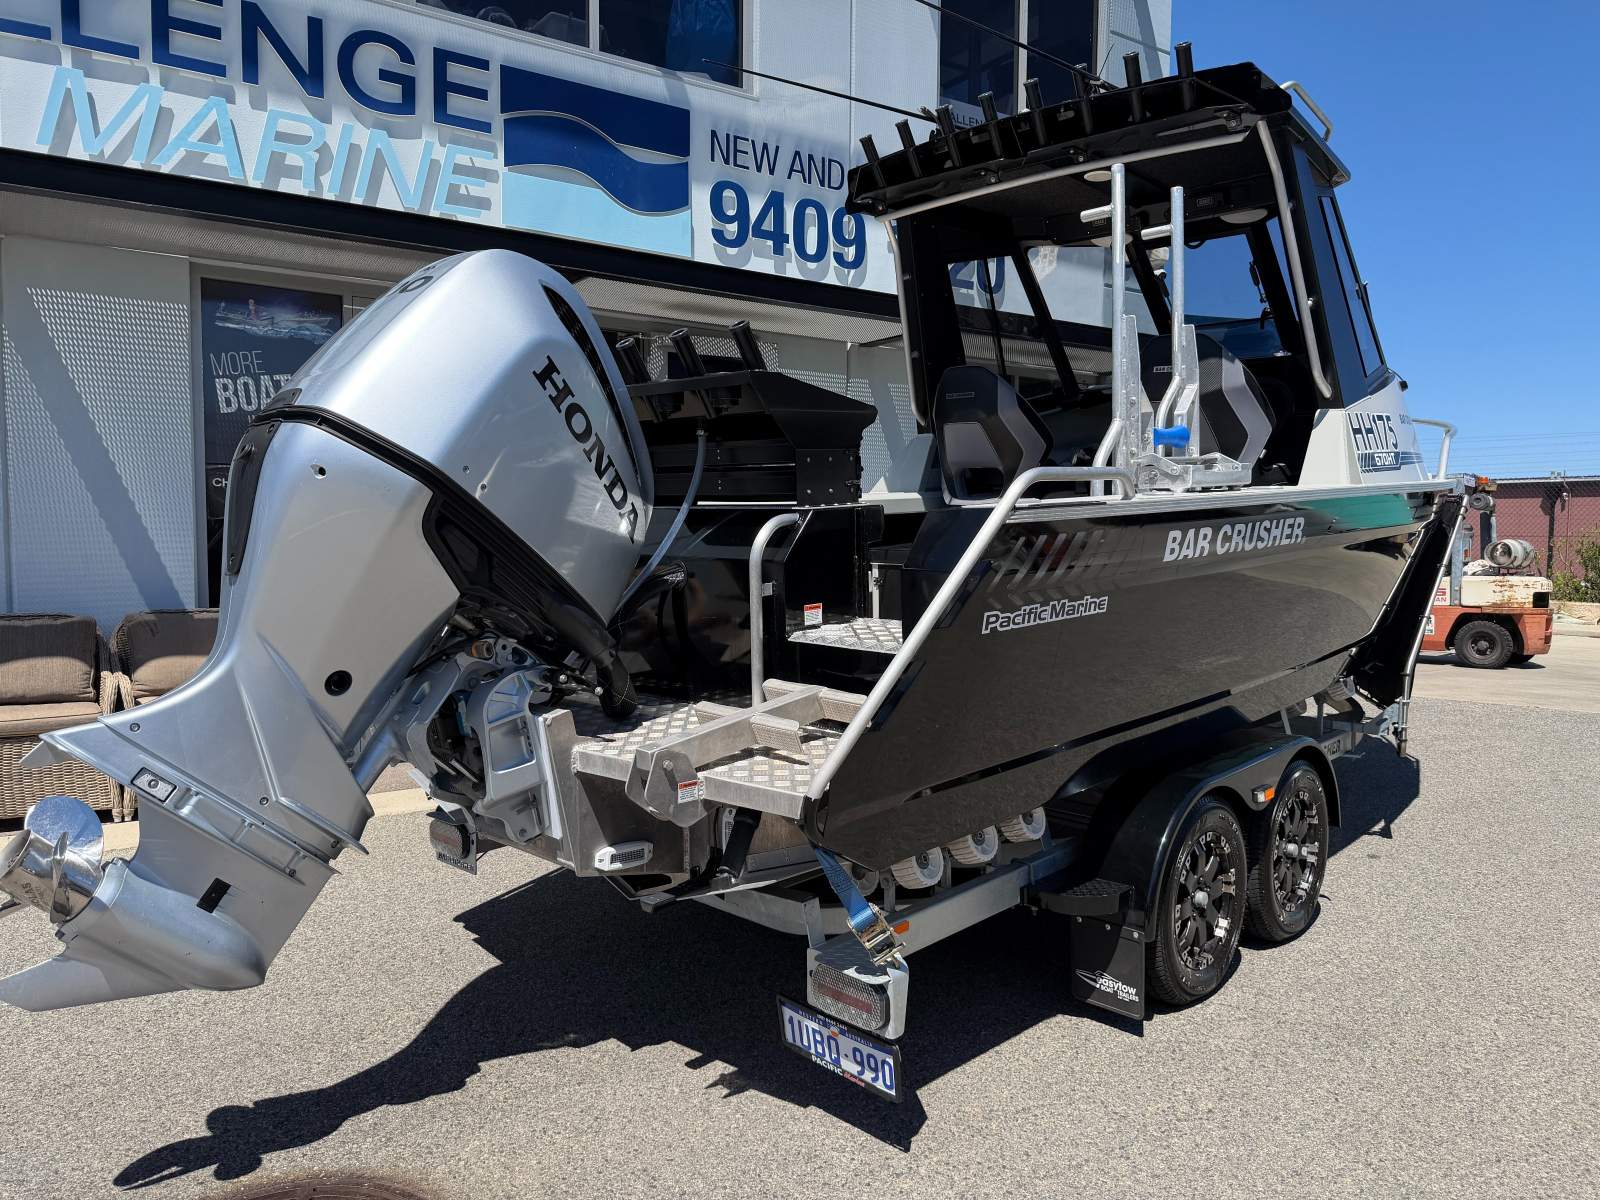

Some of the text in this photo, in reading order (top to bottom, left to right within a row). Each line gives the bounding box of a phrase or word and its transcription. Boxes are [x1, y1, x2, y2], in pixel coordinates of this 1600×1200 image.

[0, 0, 491, 134] LENGE
[35, 65, 498, 219] MARINE
[710, 129, 845, 192] NEW AND
[709, 180, 867, 270] 9409
[209, 350, 265, 376] MORE
[533, 354, 639, 545] HONDA
[1347, 412, 1399, 451] HH175
[1163, 516, 1306, 563] BAR CRUSHER
[981, 595, 1109, 635] Pacific Marine
[811, 1054, 844, 1077] PACIFIC
